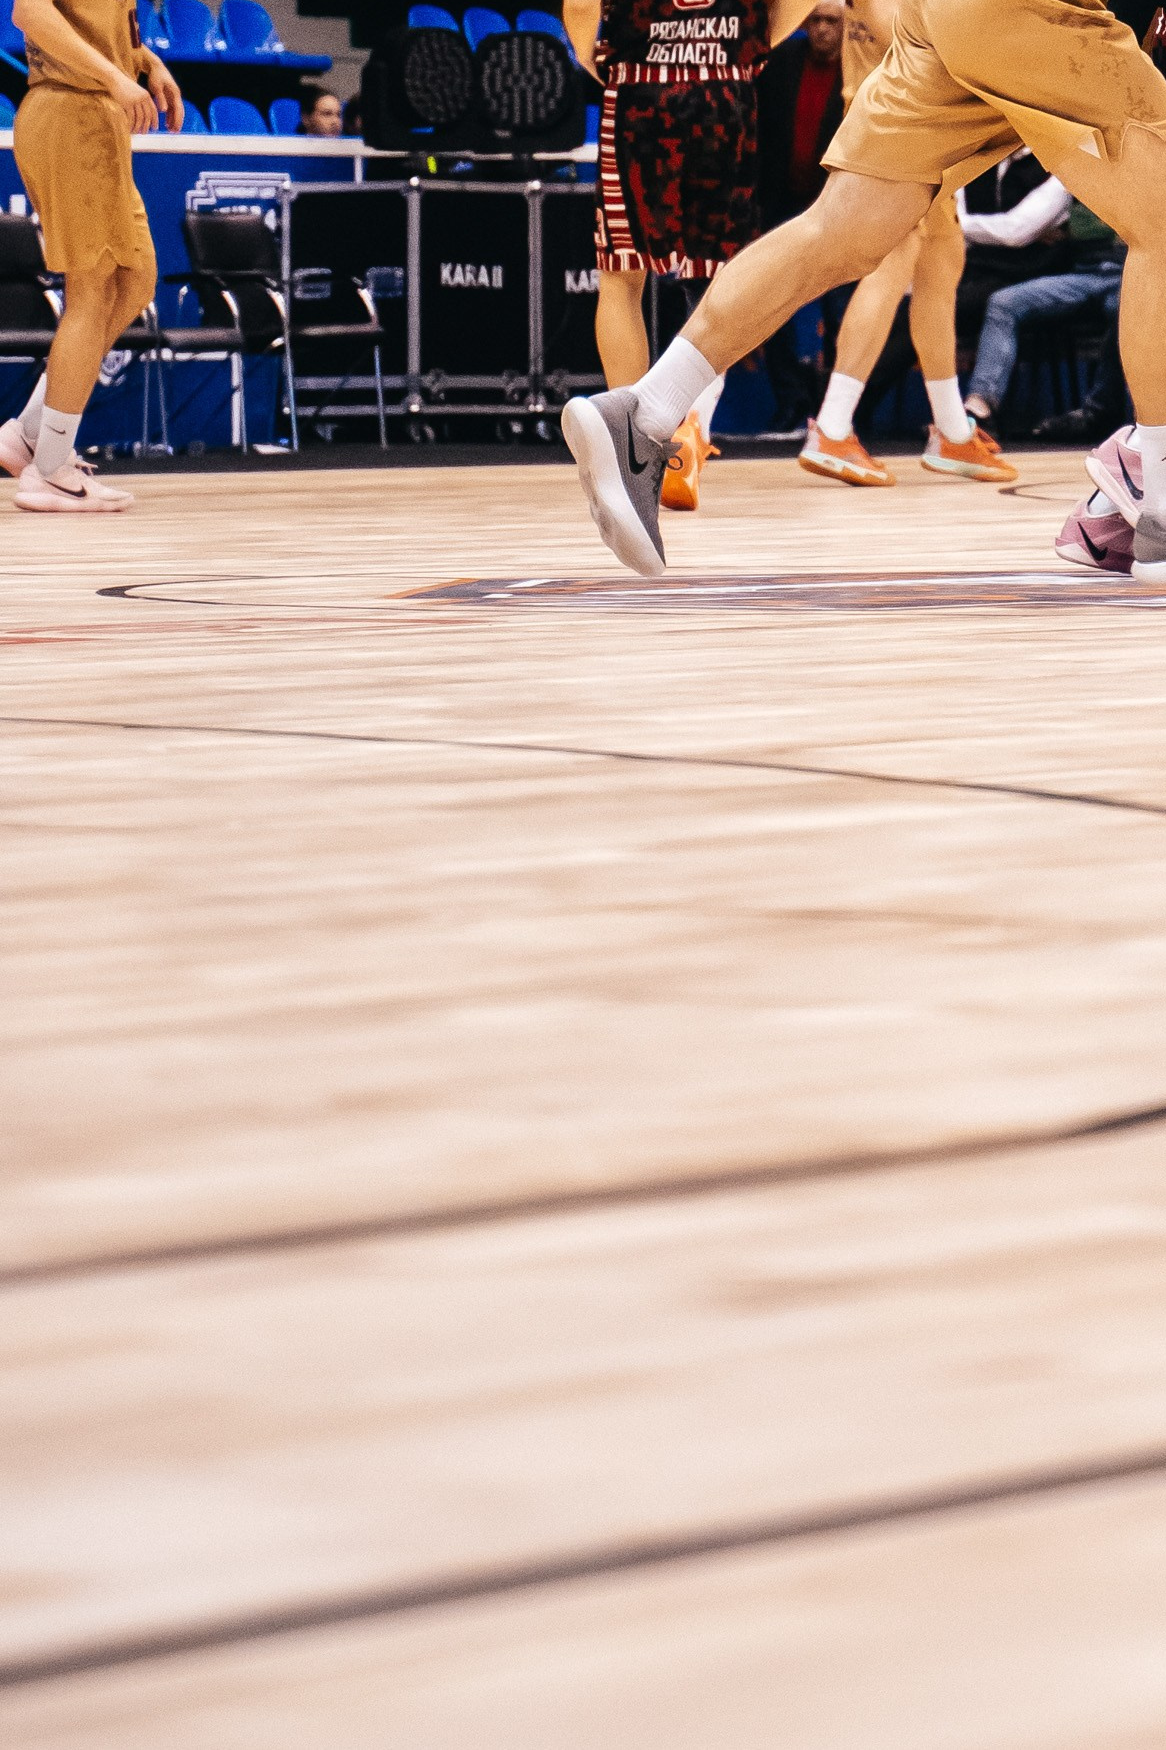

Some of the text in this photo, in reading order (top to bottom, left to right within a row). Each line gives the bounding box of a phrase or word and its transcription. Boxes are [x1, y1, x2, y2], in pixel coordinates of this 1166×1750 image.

[650, 16, 740, 40] РЯЗАНСКАЯ
[646, 42, 728, 65] ОБЛАСТЬ
[440, 262, 490, 287] KARA
[565, 268, 600, 292] KAR
